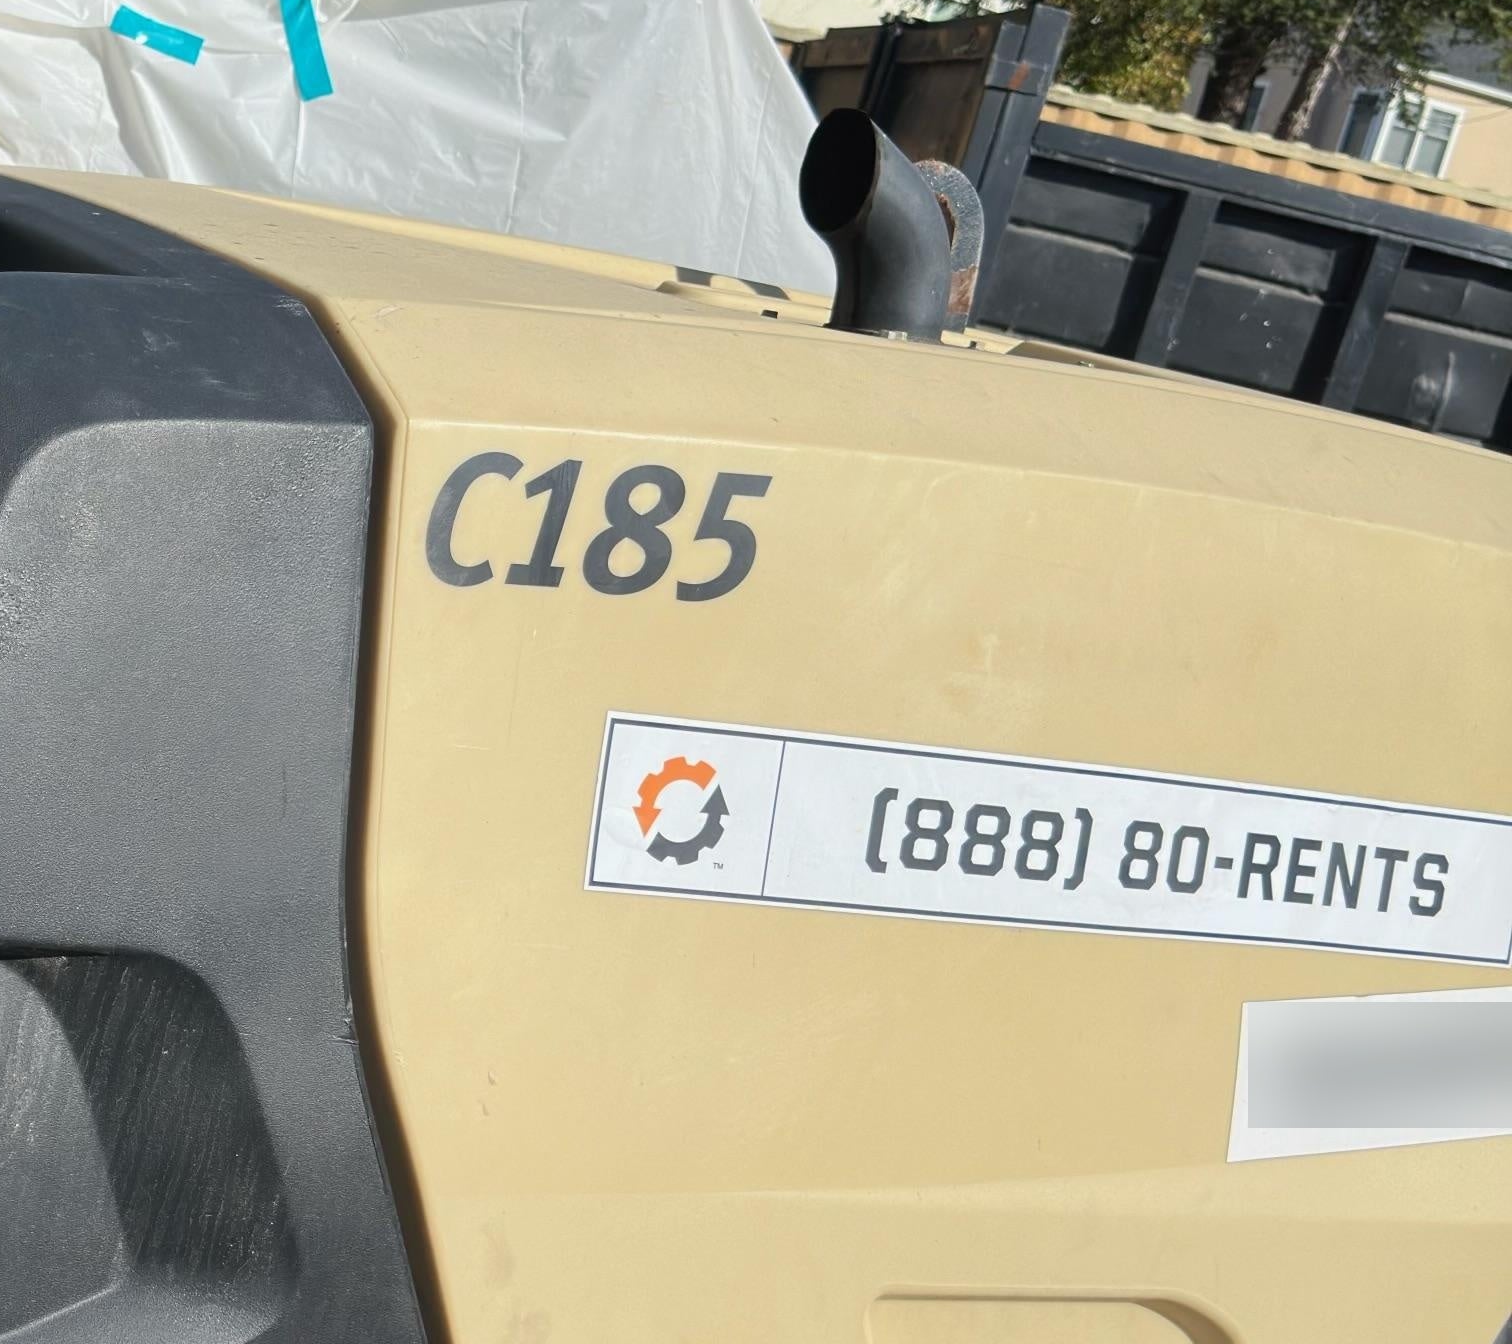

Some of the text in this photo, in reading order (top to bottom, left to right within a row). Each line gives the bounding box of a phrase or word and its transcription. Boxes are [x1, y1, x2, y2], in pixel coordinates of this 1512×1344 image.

[425, 450, 772, 602] C185
[865, 787, 1450, 918] (888) 80-RENTS
